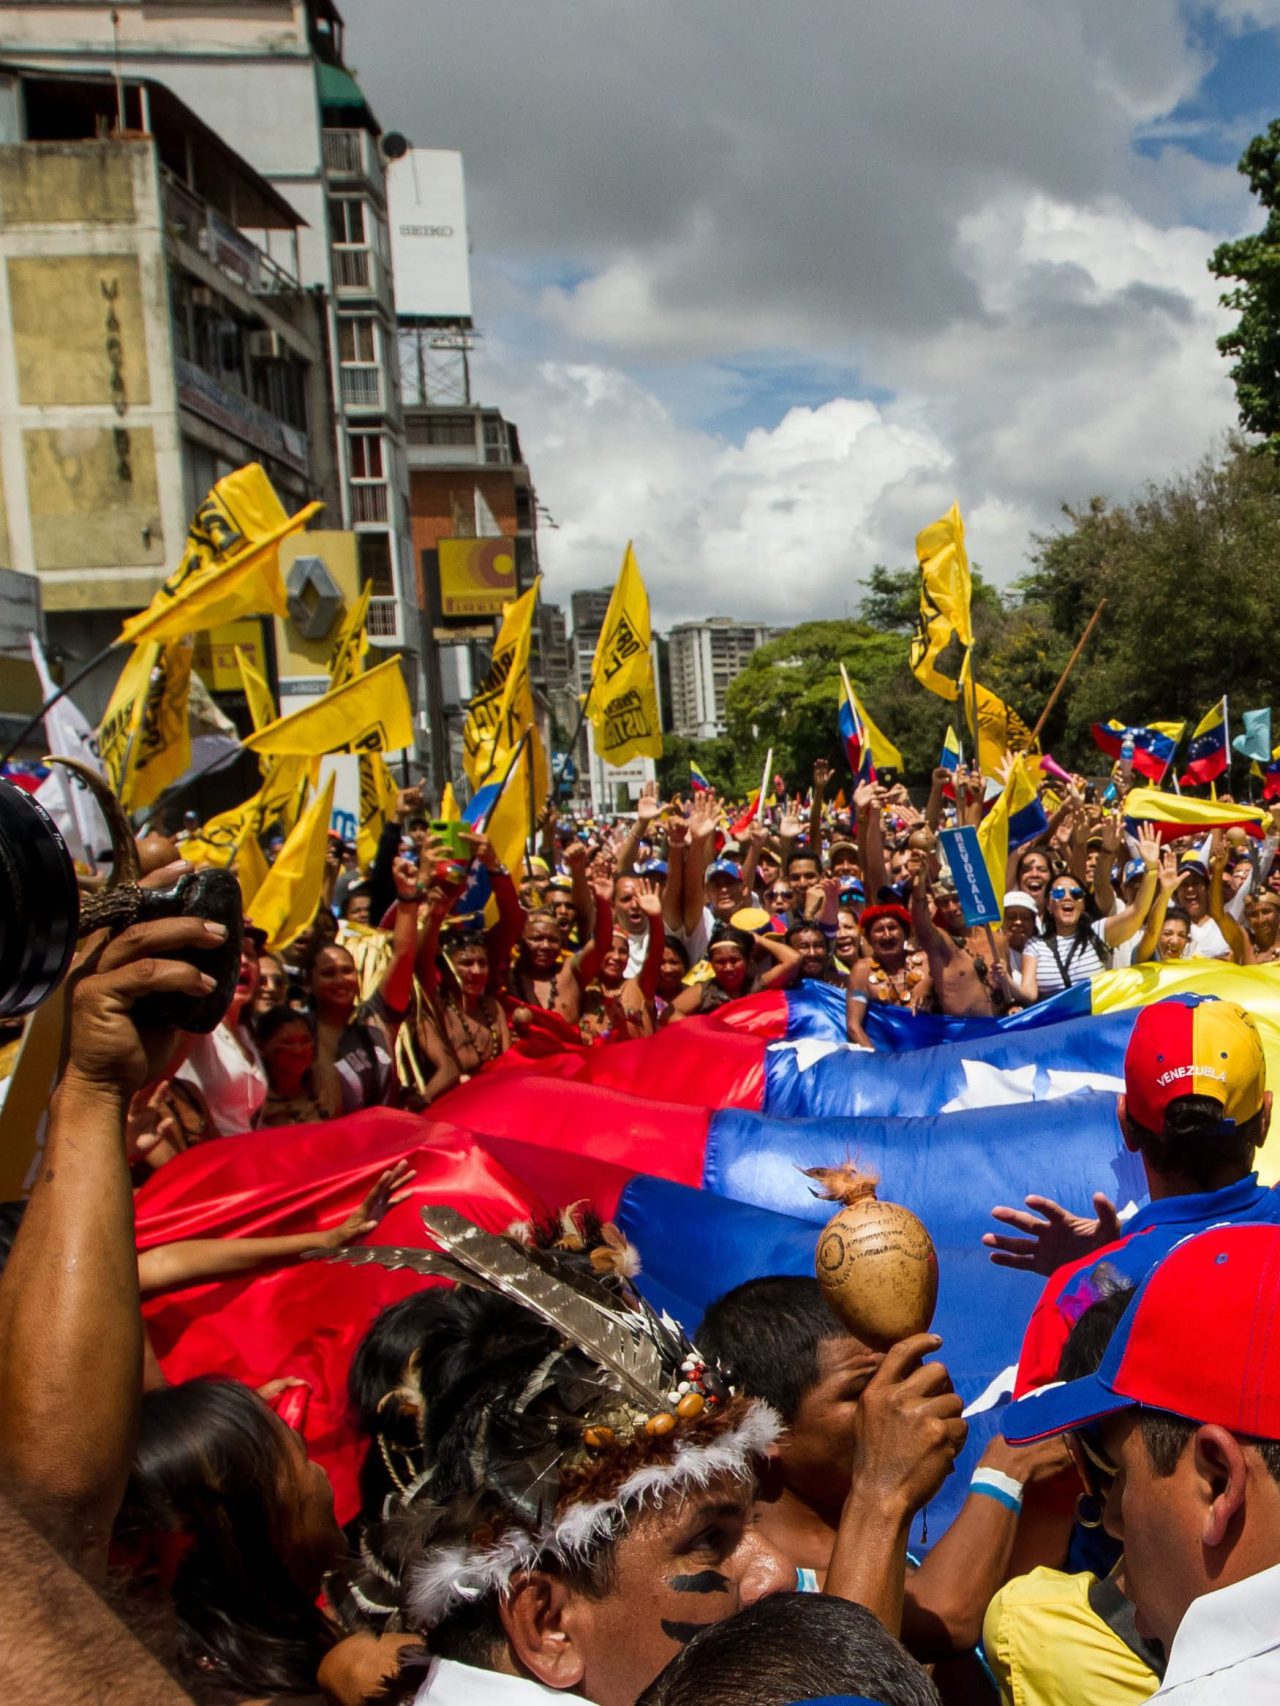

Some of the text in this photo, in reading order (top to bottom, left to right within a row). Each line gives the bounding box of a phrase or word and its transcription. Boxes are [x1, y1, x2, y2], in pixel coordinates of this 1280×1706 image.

[400, 225, 453, 237] SEIKO
[954, 831, 987, 914] REVOCALO
[1156, 1064, 1228, 1087] VENEZUELA
